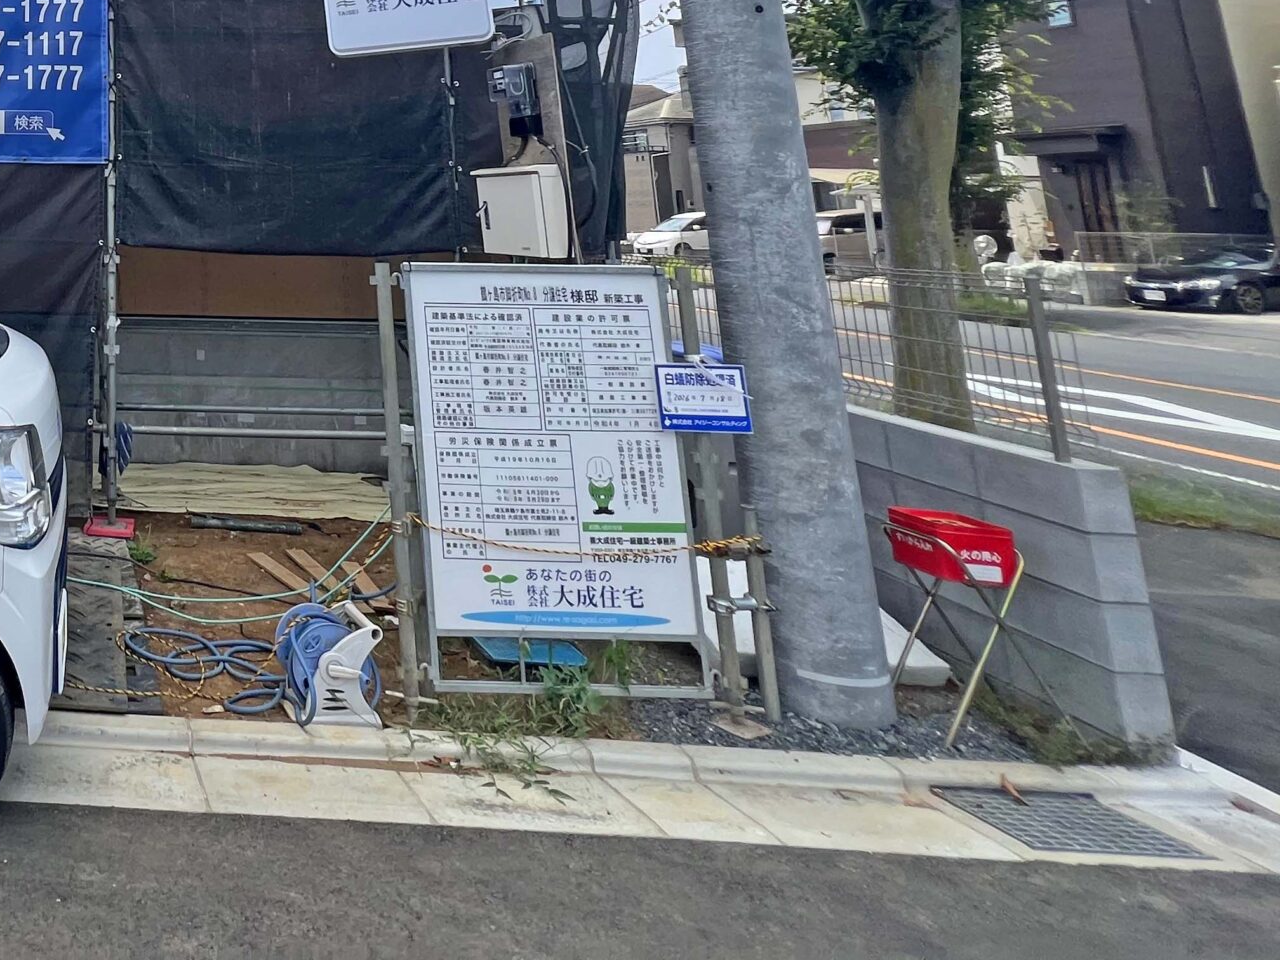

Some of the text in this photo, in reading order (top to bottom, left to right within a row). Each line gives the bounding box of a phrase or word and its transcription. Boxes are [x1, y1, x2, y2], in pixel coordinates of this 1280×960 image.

[13, 115, 44, 131] 検索
[603, 294, 644, 304] 新築工事
[526, 568, 612, 583] あなたの街の
[491, 598, 515, 606] TAISEI
[553, 584, 645, 608] 大成住宅
